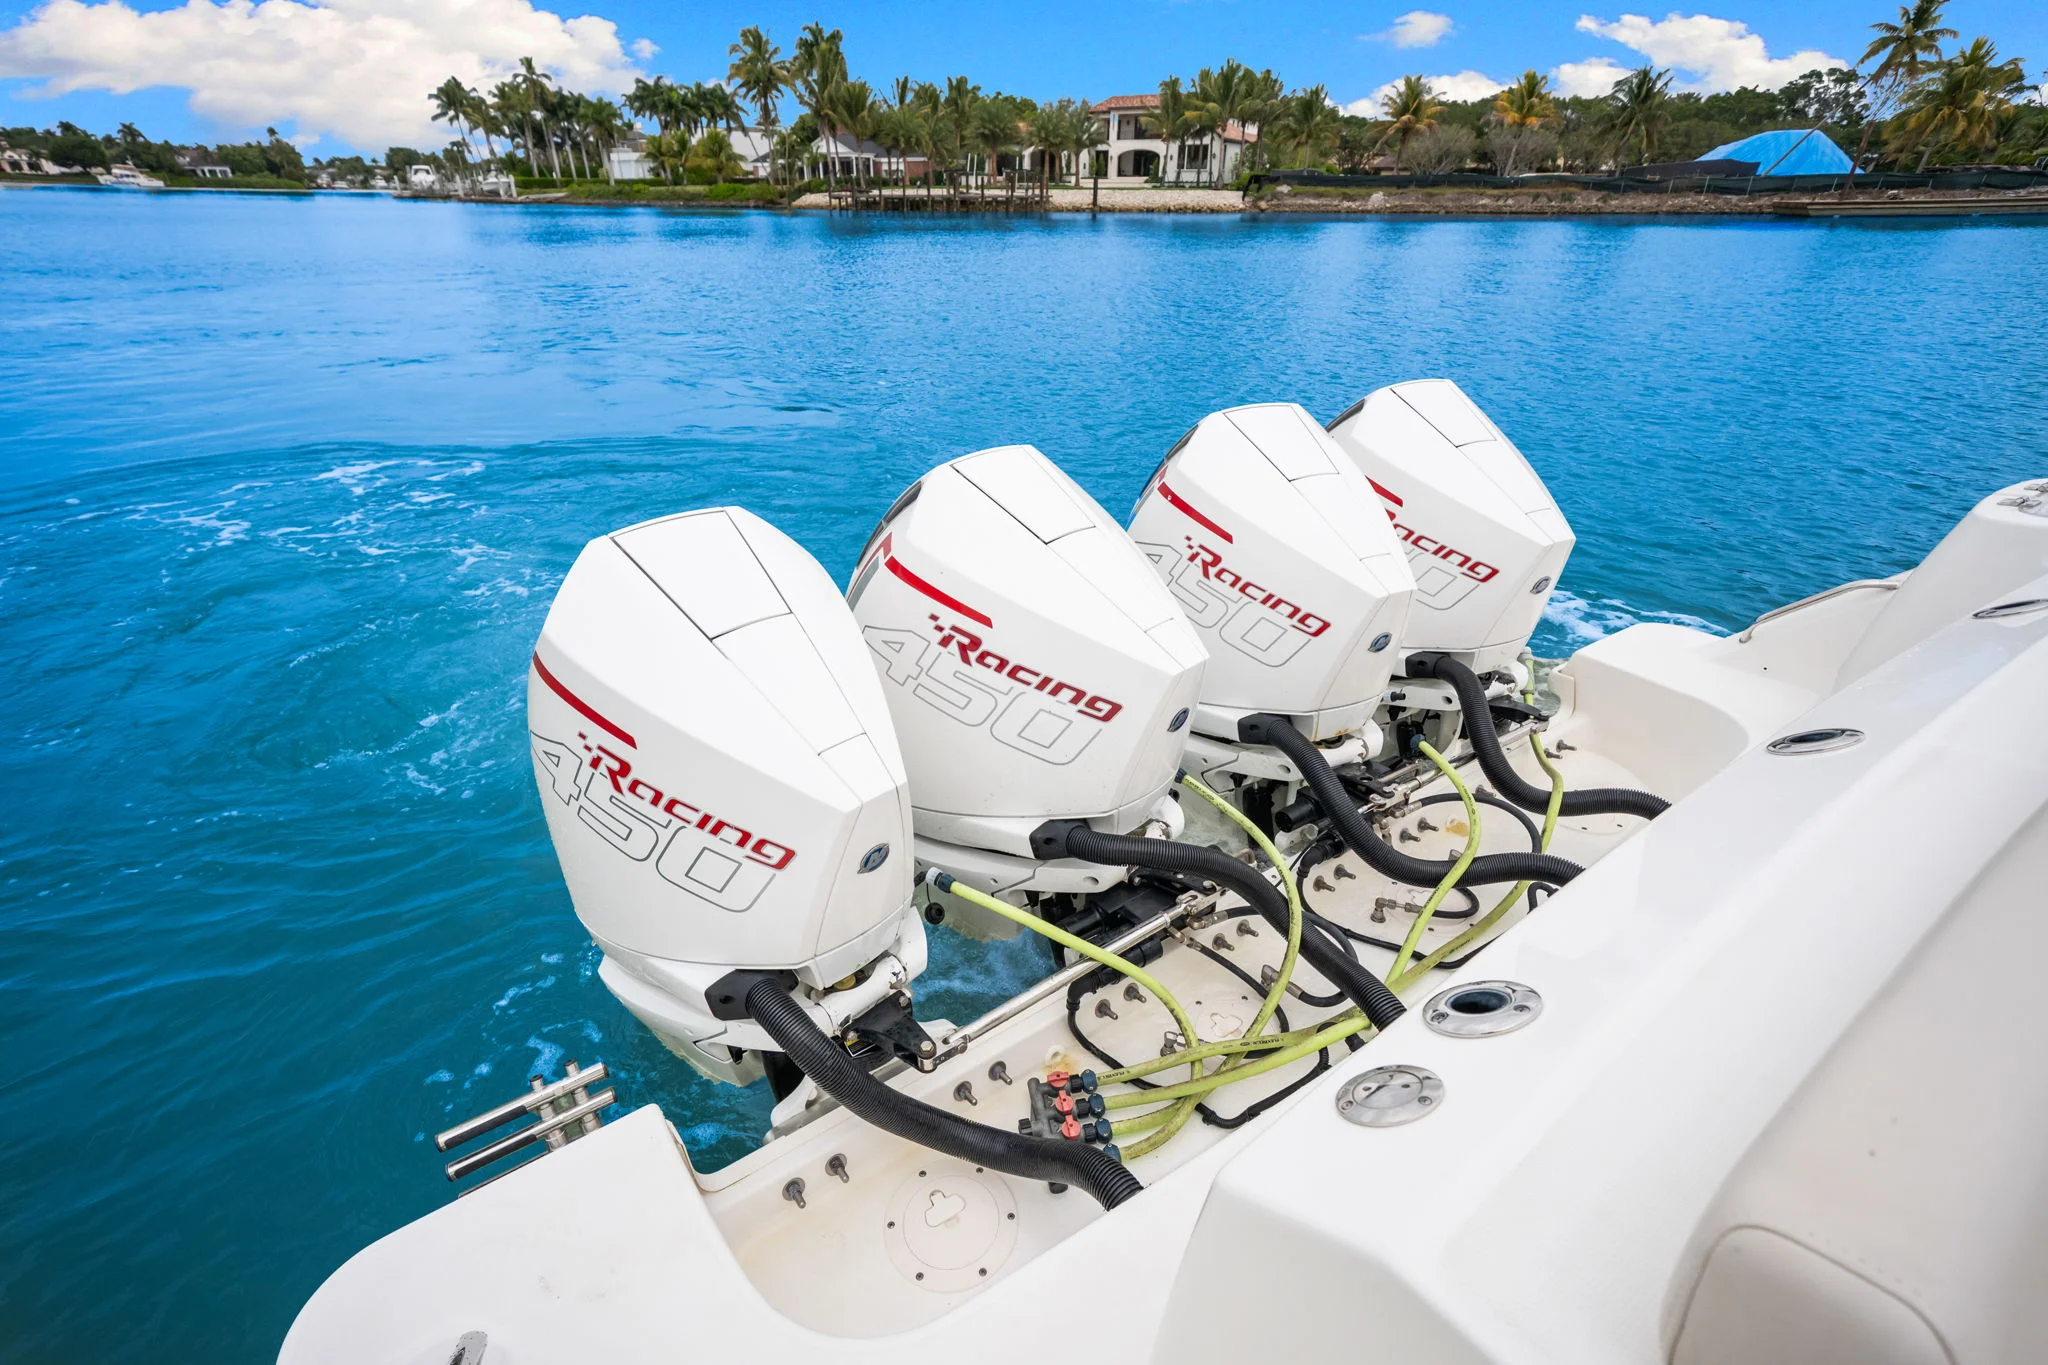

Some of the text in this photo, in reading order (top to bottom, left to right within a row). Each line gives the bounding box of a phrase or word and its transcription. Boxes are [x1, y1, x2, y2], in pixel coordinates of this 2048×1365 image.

[1134, 540, 1312, 668] 450
[1187, 543, 1332, 638] Racing
[1385, 508, 1499, 583] acing
[861, 624, 1103, 766] 450
[937, 624, 1123, 723] Racing
[530, 729, 777, 914] 450
[589, 744, 798, 871] Racing
